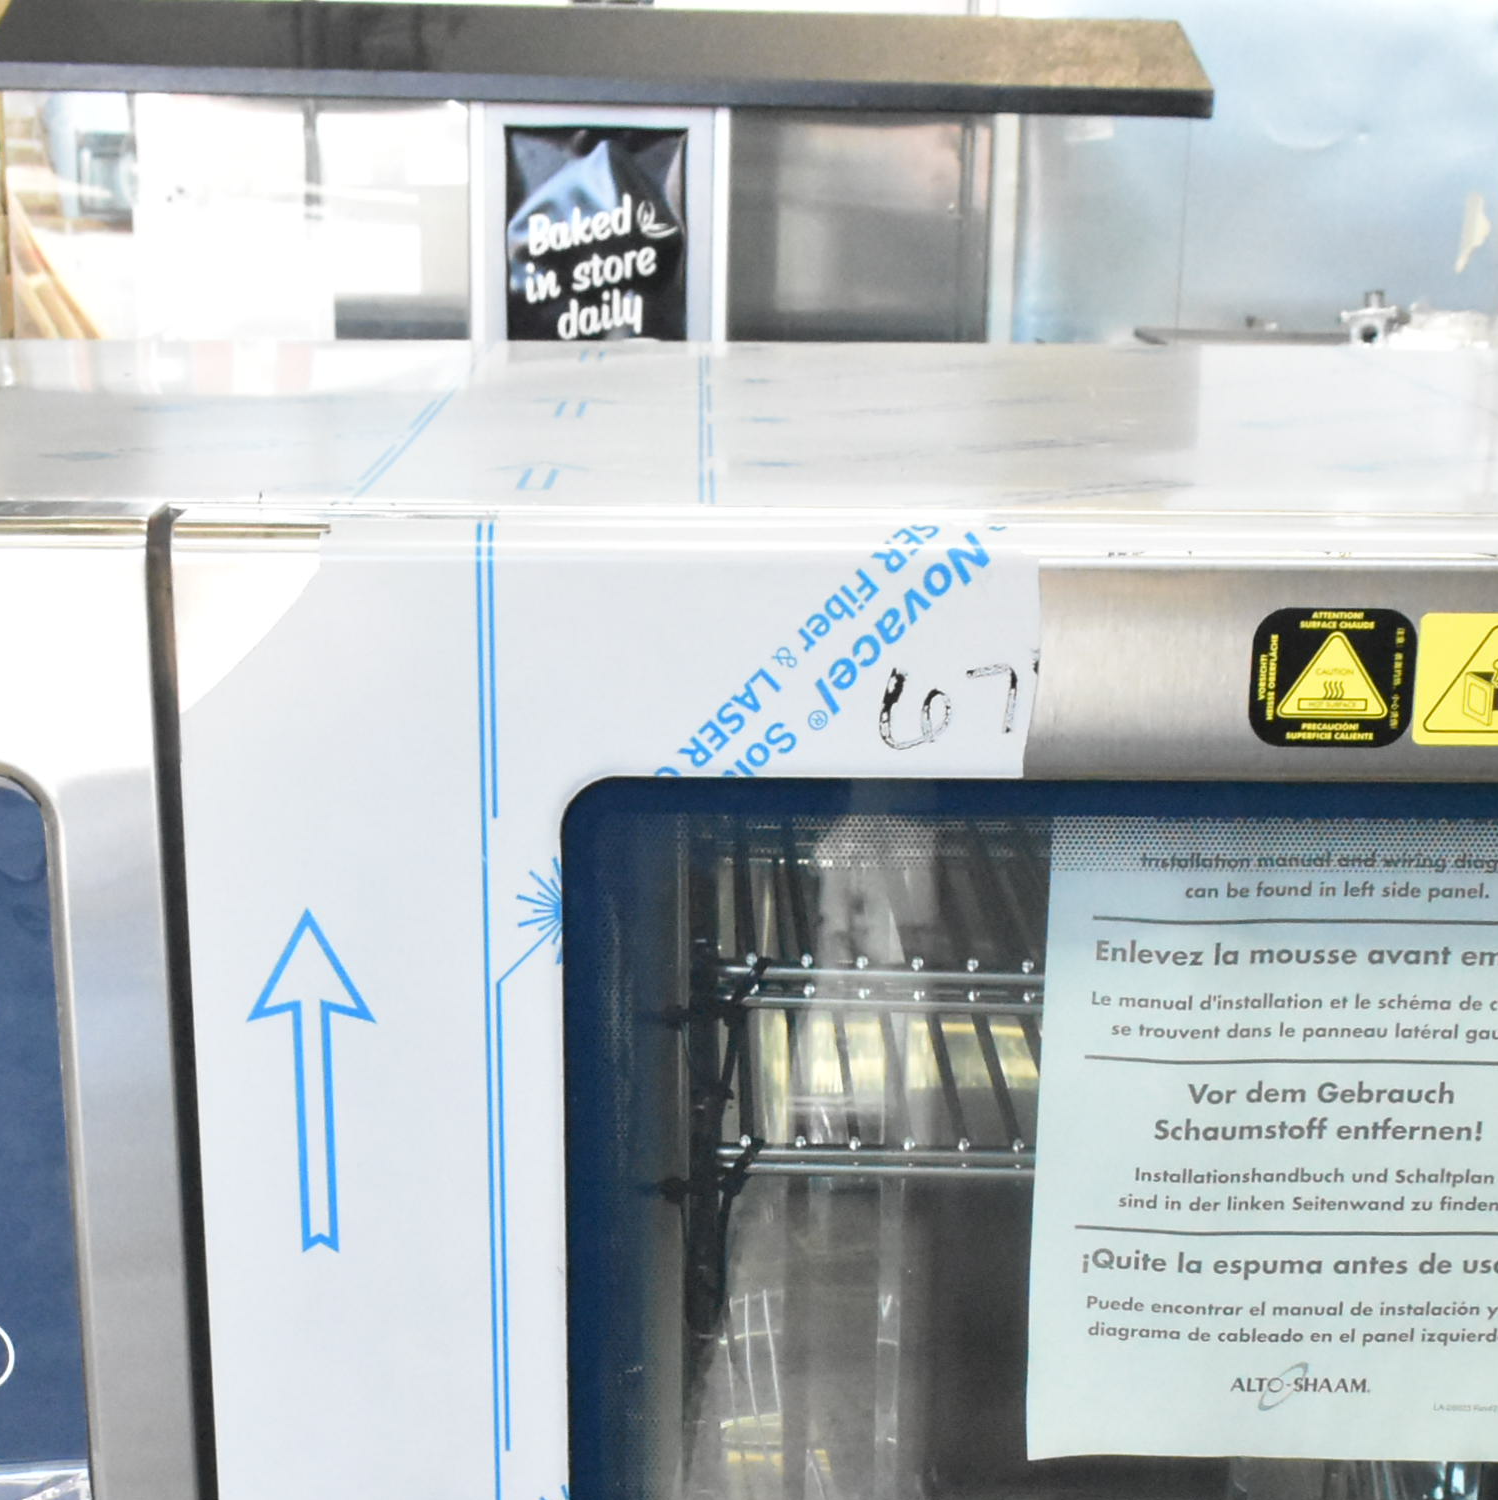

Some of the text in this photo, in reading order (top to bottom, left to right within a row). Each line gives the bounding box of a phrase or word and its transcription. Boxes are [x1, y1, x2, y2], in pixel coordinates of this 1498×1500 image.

[528, 193, 631, 256] Baked
[525, 247, 657, 303] in store
[558, 288, 643, 340] daily
[798, 569, 879, 652] Fiber
[1312, 611, 1364, 619] ATTENTION!
[1300, 621, 1375, 629] SURFACE CHAUDE
[772, 647, 797, 668] &
[677, 668, 782, 768] LASER
[1286, 732, 1373, 740] SUPERFICIE CALIENTE
[1142, 852, 1251, 872] Installation
[1257, 853, 1333, 872] manual
[1339, 853, 1377, 872] and
[1384, 853, 1446, 874] wiring
[1184, 880, 1490, 903] can be found in left side panel.
[1096, 939, 1204, 967] Enlevez
[1214, 942, 1240, 966] la
[1249, 948, 1358, 965] mousse
[1367, 945, 1452, 966] avant
[1091, 990, 1112, 1007] Le
[1118, 994, 1194, 1011] manual
[1199, 992, 1323, 1011] d'installation
[1329, 996, 1349, 1010] et
[1354, 992, 1372, 1010] le
[1377, 993, 1452, 1011] schéma
[1458, 994, 1483, 1012] de
[1111, 1024, 1132, 1037] se
[1138, 1023, 1221, 1040] trouvent
[1226, 1022, 1272, 1039] dans
[1279, 1021, 1296, 1038] le
[1302, 1027, 1388, 1043] panneau
[1394, 1022, 1460, 1040] latéral
[1187, 1079, 1455, 1105] Vor dem Gebrauch
[1154, 1116, 1483, 1142] Schaumstoff entfernen!
[1134, 1167, 1495, 1188] Installationshandbuch und Schaltplan
[1118, 1193, 1158, 1210] sind
[1164, 1195, 1182, 1211] in
[1188, 1196, 1222, 1212] der
[1226, 1194, 1285, 1211] linken
[1292, 1195, 1405, 1212] Seitenwand
[1410, 1200, 1433, 1212] zu
[1082, 1248, 1168, 1274] ¡Quite
[1177, 1251, 1203, 1274] la
[1212, 1259, 1323, 1281] espuma
[1332, 1256, 1408, 1275] antes
[1418, 1251, 1453, 1275] de
[1086, 1295, 1145, 1312] Puede
[1150, 1302, 1244, 1317] encontrar
[1248, 1300, 1266, 1317] el
[1272, 1300, 1344, 1317] manual
[1349, 1301, 1374, 1317] de
[1379, 1300, 1481, 1317] instalación
[1486, 1305, 1498, 1321] y
[1087, 1320, 1181, 1342] diagrama
[1187, 1326, 1211, 1343] de
[1217, 1327, 1304, 1343] cableado
[1309, 1332, 1333, 1343] en
[1338, 1327, 1356, 1344] el
[1361, 1327, 1415, 1348] panel
